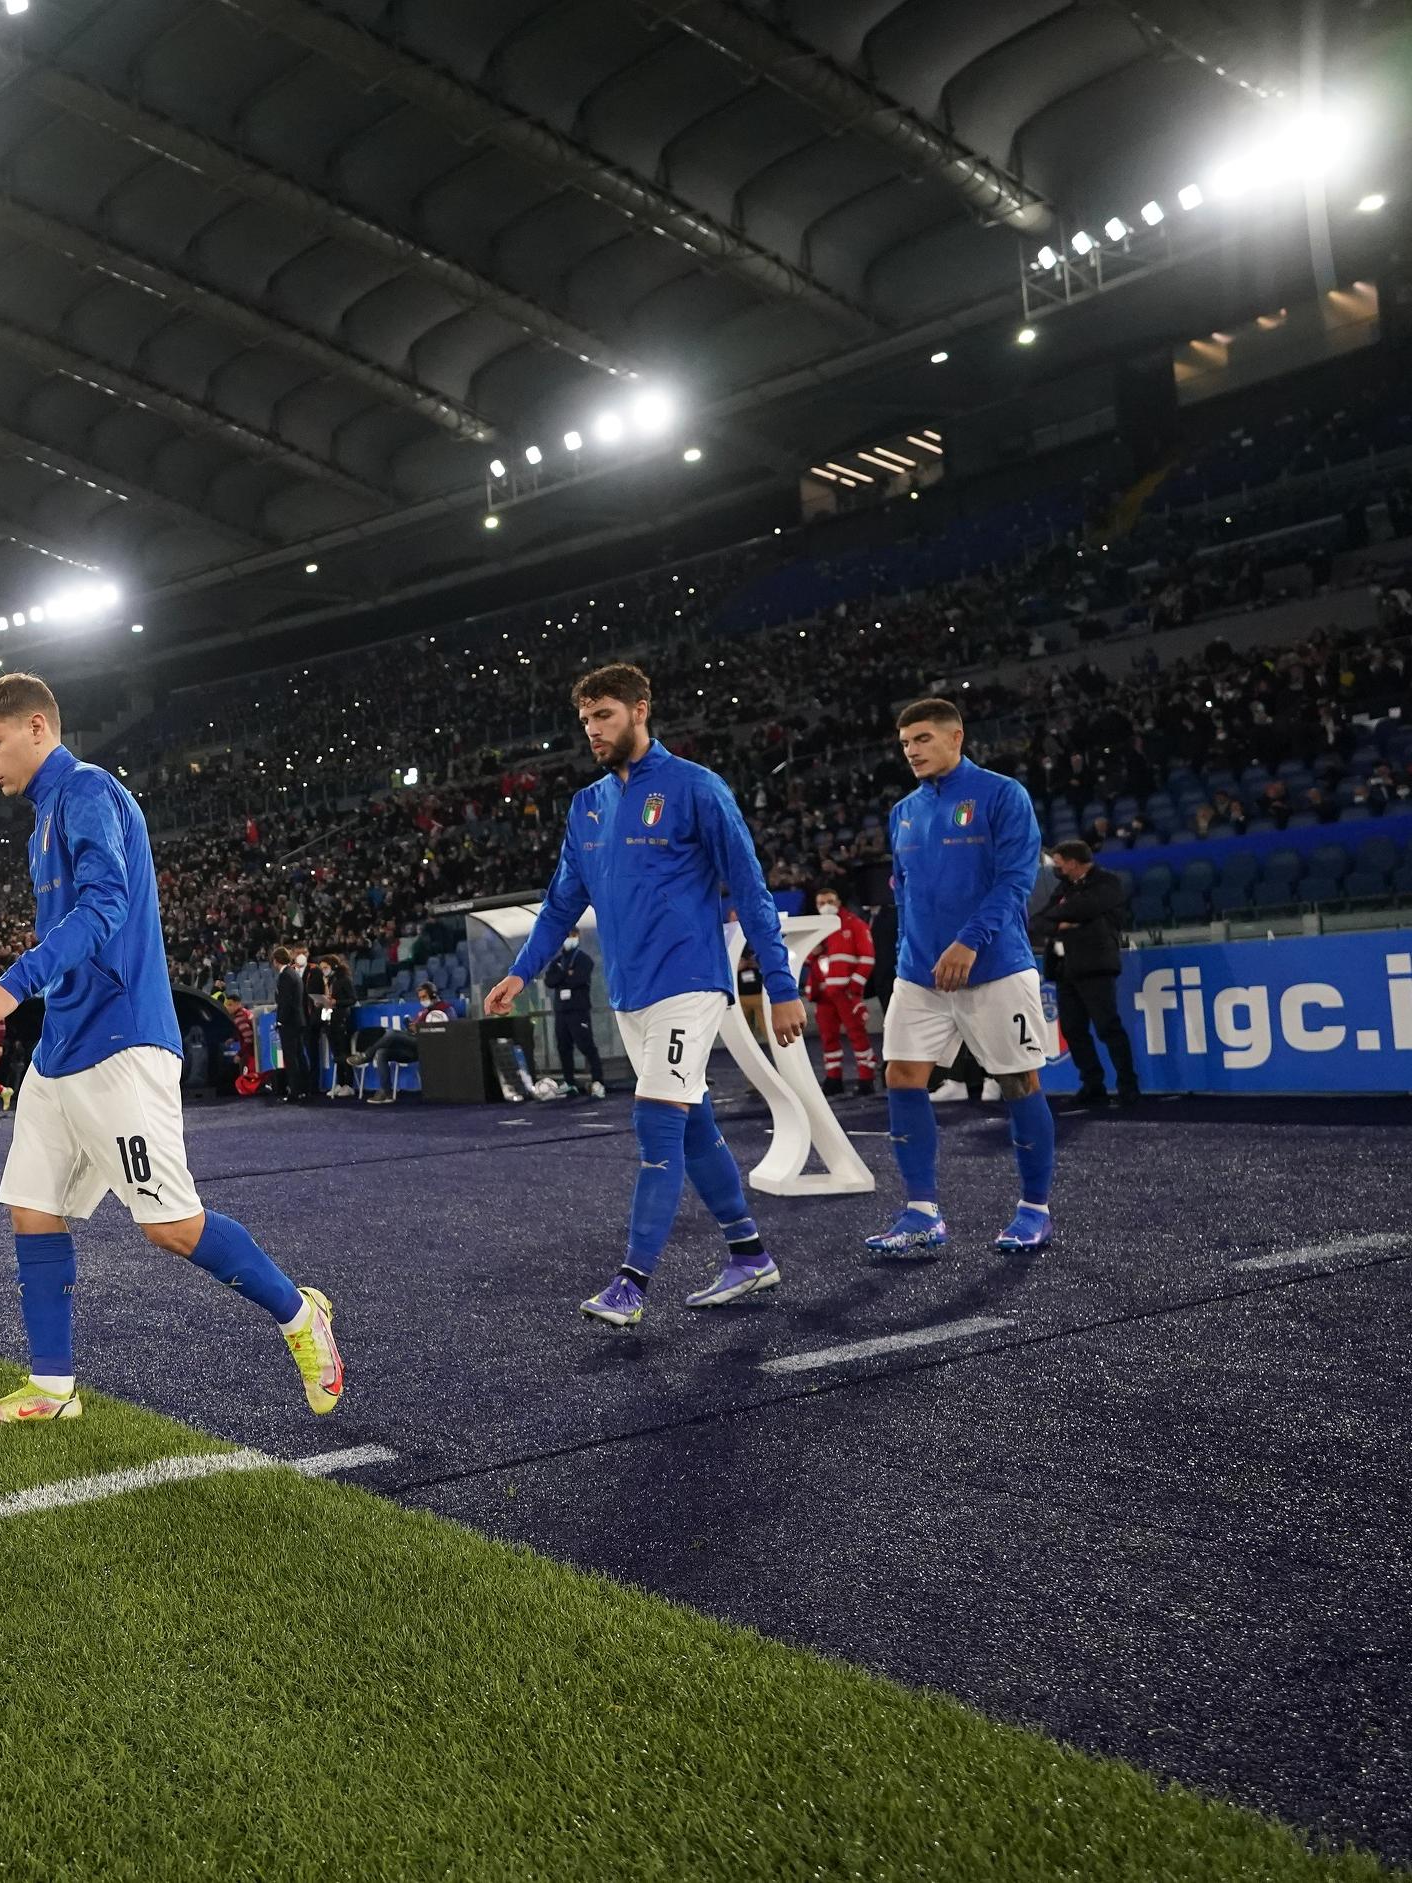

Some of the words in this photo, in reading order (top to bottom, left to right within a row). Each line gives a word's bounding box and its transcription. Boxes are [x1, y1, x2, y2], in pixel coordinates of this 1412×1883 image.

[668, 1029, 685, 1064] 5
[1013, 1013, 1032, 1045] 2
[116, 1135, 151, 1183] 18
